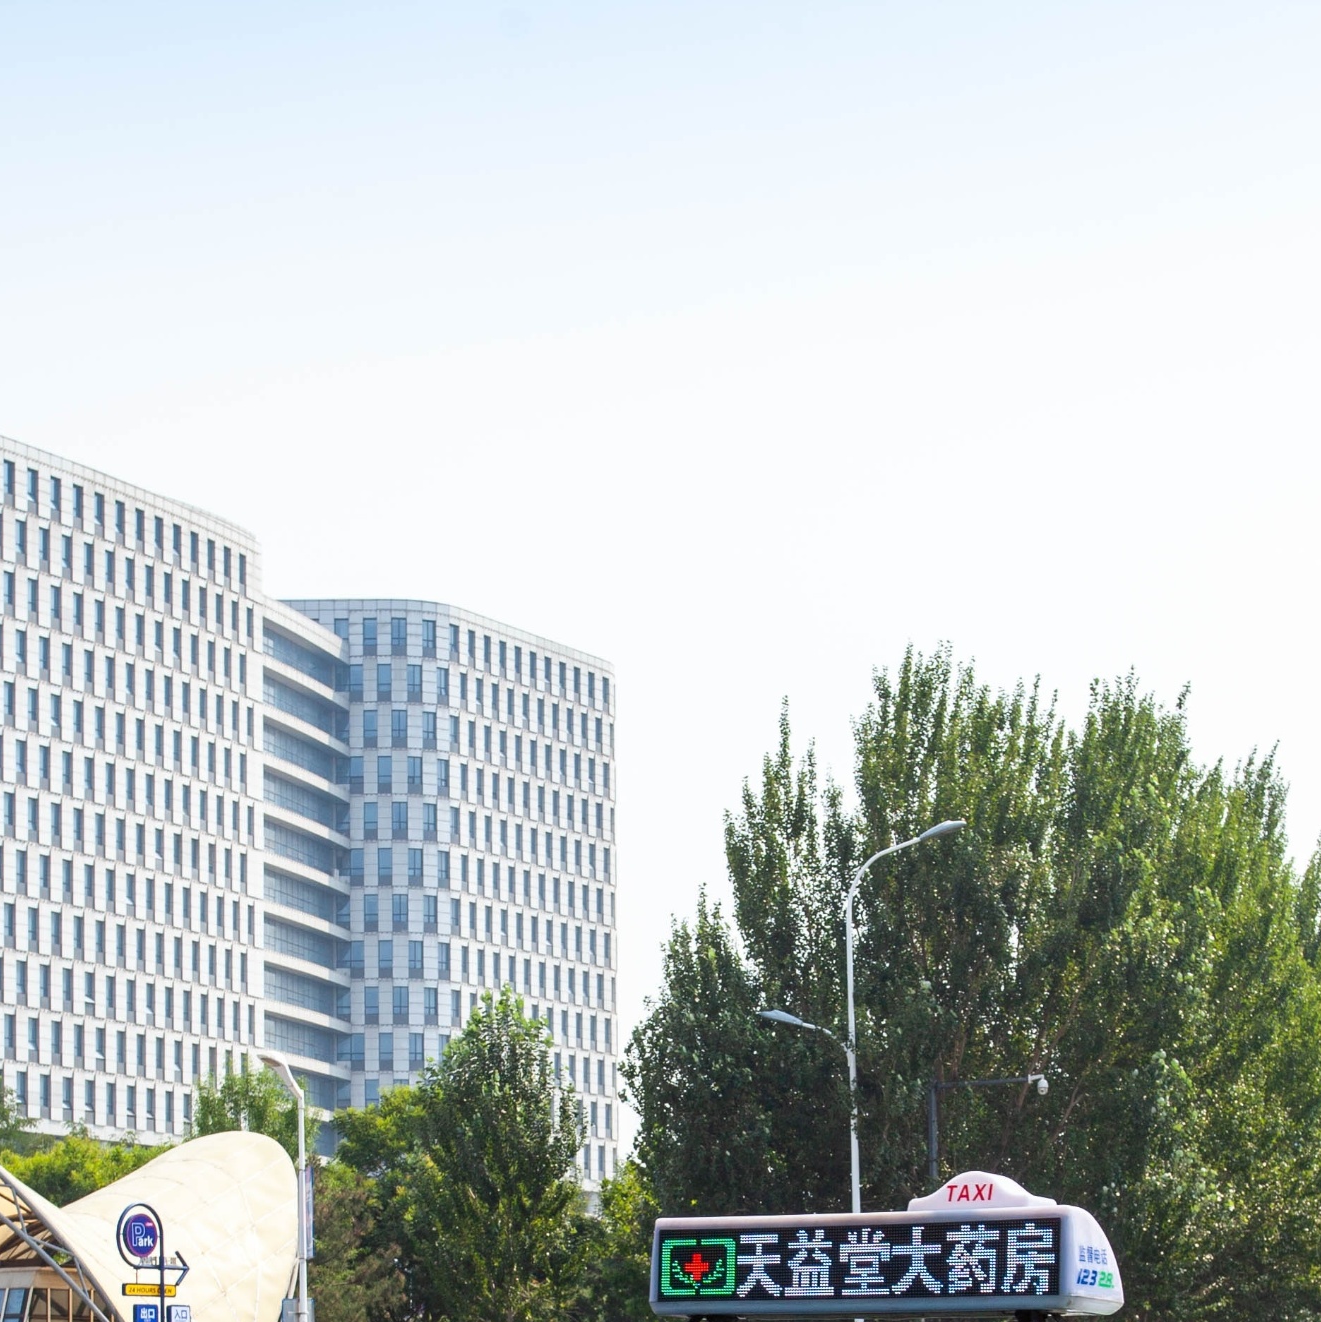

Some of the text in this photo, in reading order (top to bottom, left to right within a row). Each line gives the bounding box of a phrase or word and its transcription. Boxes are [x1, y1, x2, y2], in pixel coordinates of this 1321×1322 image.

[946, 1183, 995, 1203] TAXI
[131, 1222, 154, 1247] Park
[736, 1223, 1056, 1297] 天益堂大药房
[1079, 1245, 1108, 1266] 监督电话
[140, 1308, 155, 1319] 出口
[174, 1309, 188, 1319] 入口
